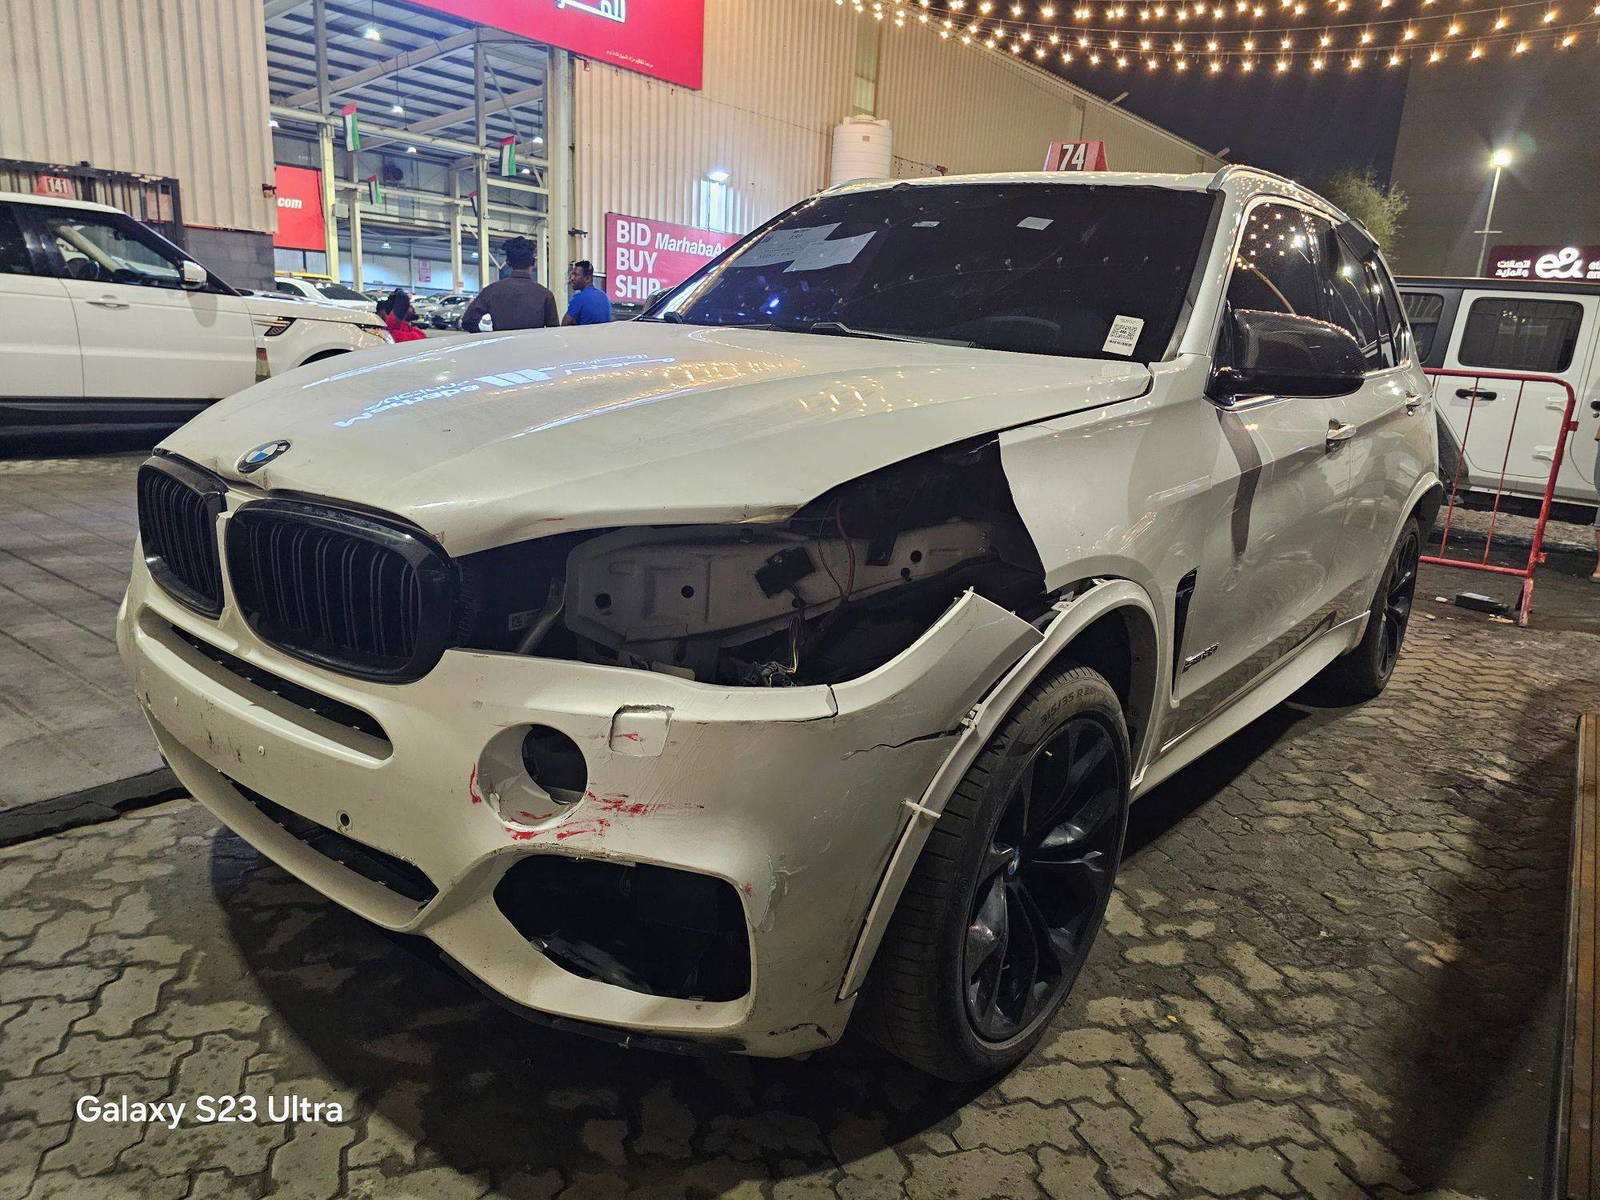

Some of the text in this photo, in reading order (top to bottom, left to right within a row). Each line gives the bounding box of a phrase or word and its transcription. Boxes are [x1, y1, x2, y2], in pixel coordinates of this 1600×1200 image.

[1060, 143, 1087, 171] 74
[47, 177, 68, 193] 141
[616, 219, 651, 247] BID
[616, 247, 658, 274] BUY
